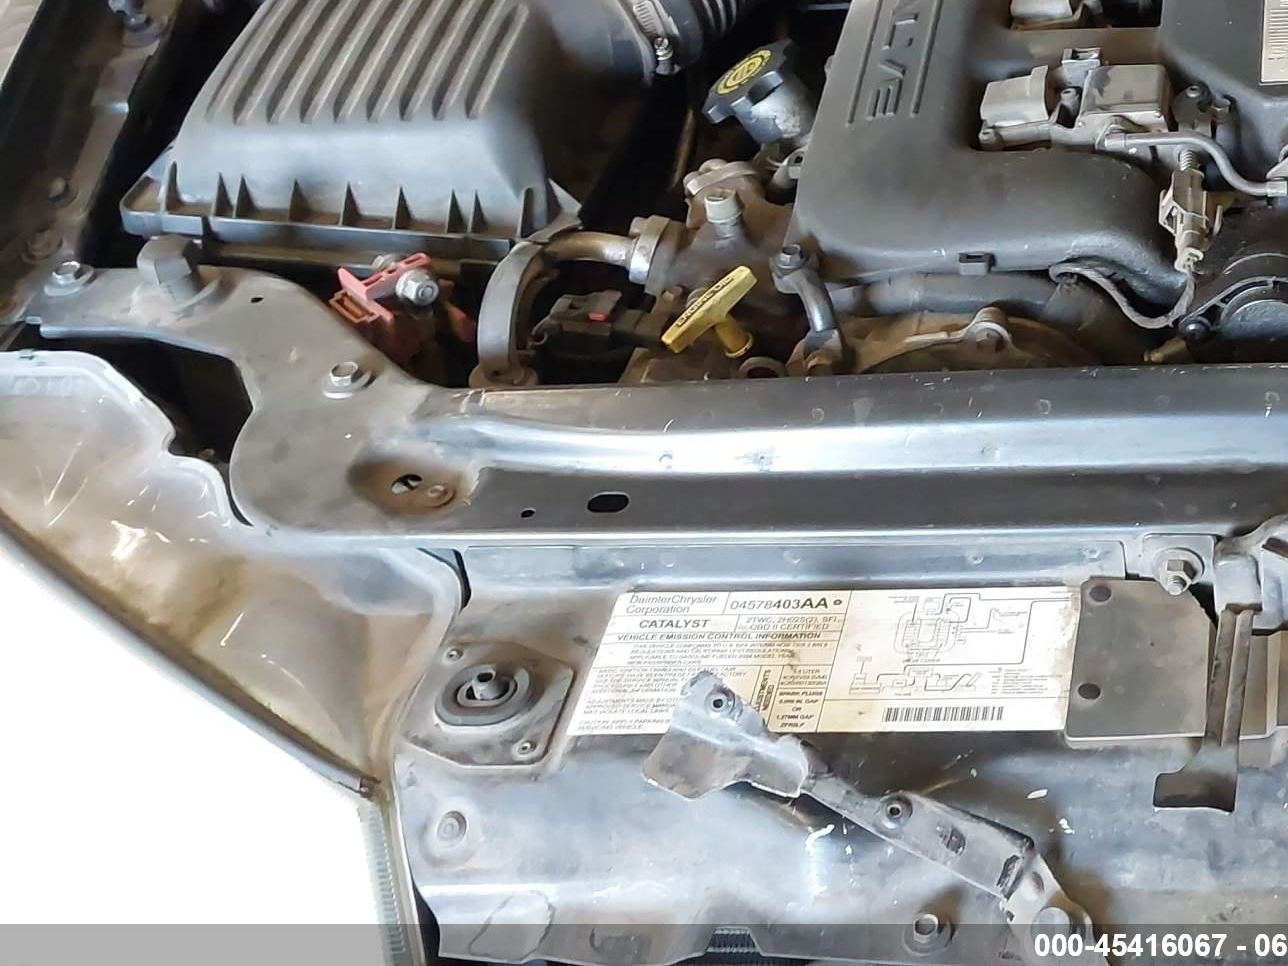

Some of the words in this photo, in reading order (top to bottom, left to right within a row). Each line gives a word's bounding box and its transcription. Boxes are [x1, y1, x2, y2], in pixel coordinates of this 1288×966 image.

[675, 290, 714, 328] ENGINE
[629, 594, 717, 606] DaimlerChrysler
[730, 597, 828, 610] 04578403AA
[626, 605, 690, 616] Corporation
[639, 619, 710, 629] CATALYST
